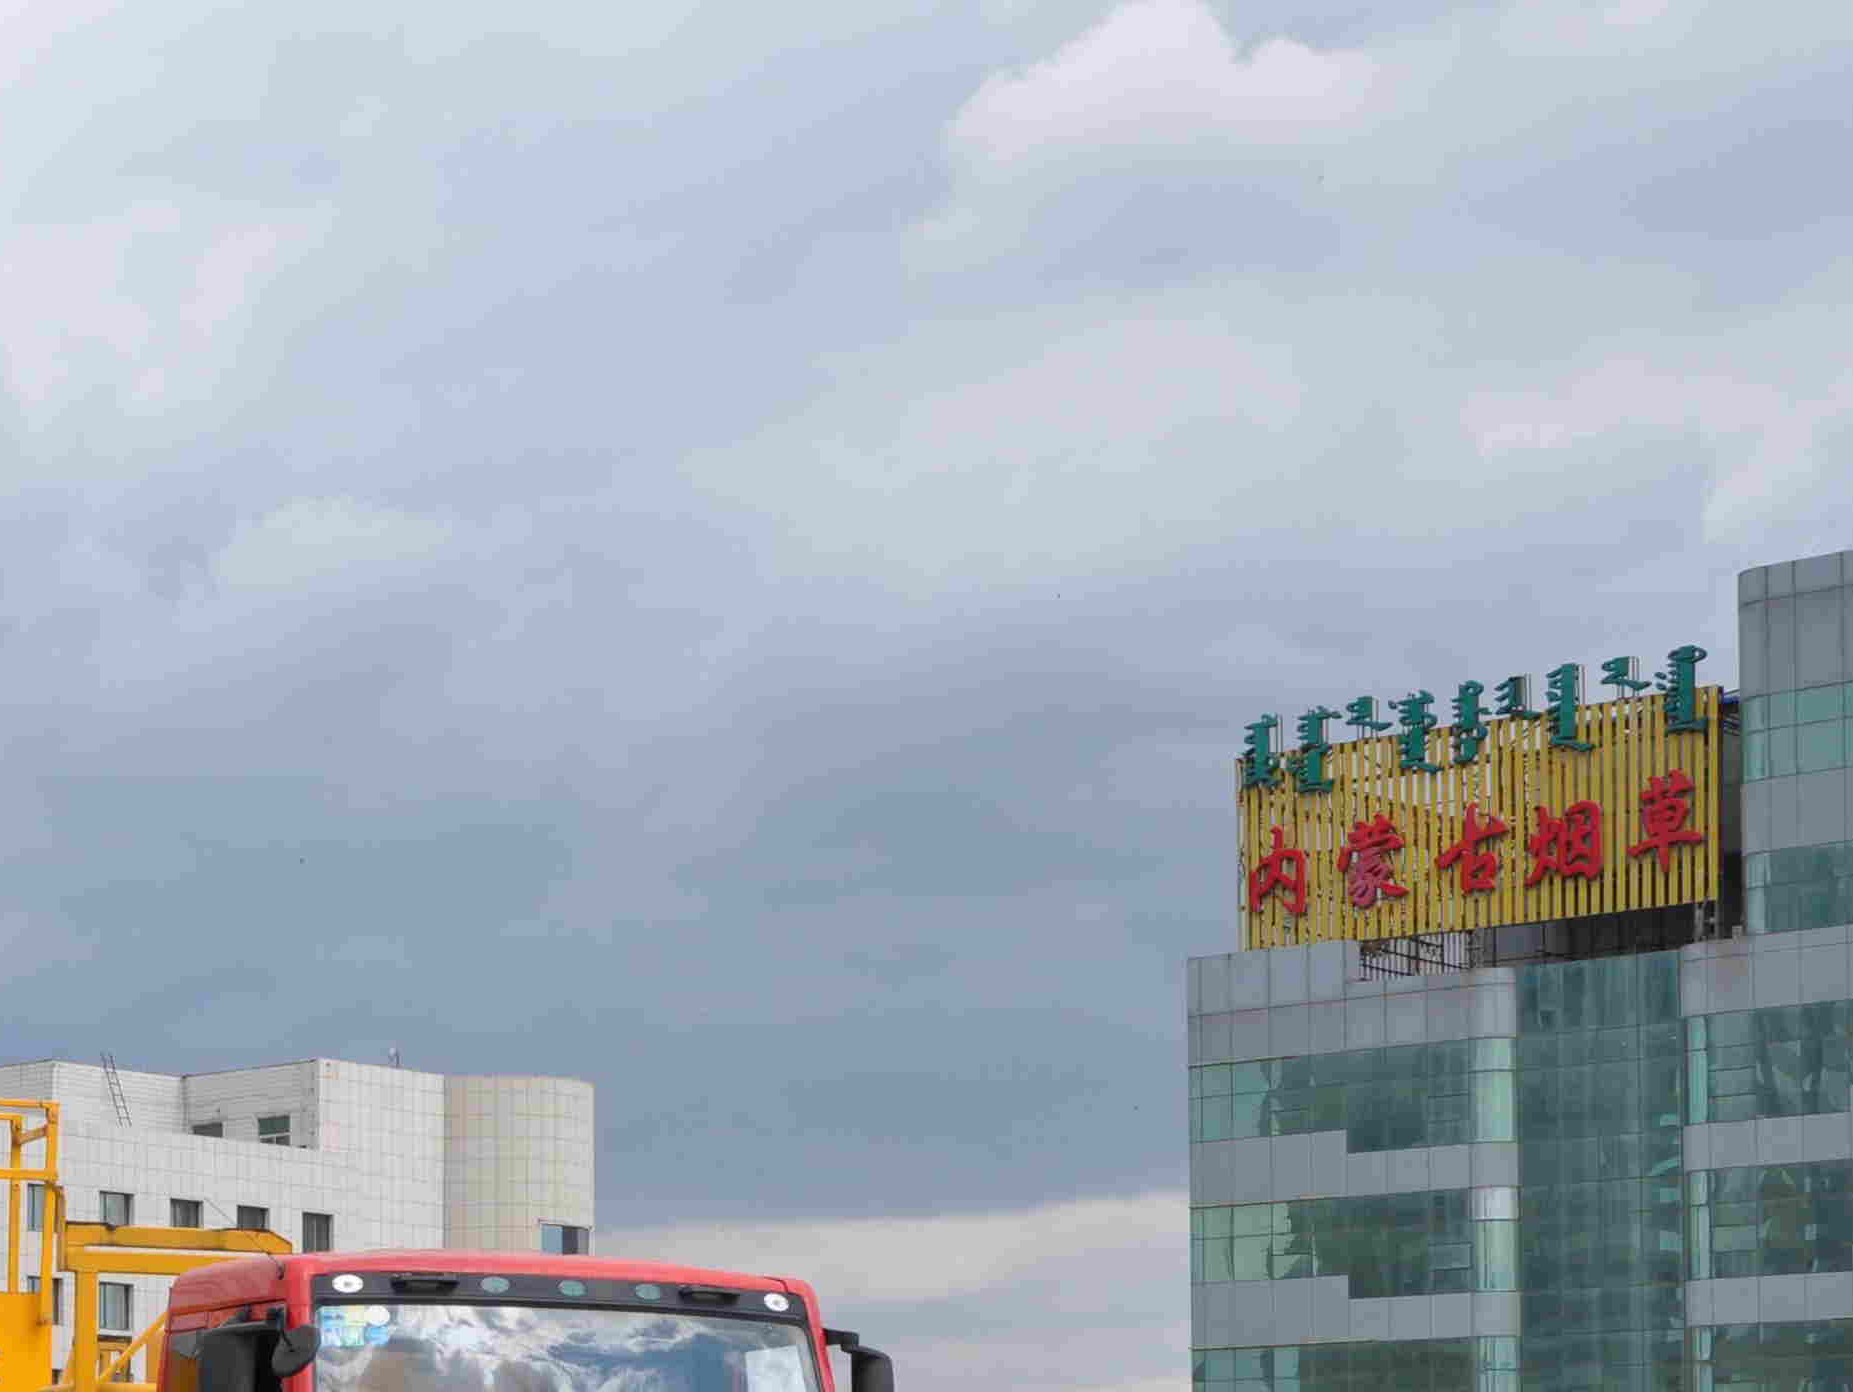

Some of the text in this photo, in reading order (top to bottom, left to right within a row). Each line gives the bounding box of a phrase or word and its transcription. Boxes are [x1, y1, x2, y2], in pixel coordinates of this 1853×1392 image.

[1249, 769, 1704, 917] 内蒙古烟草
